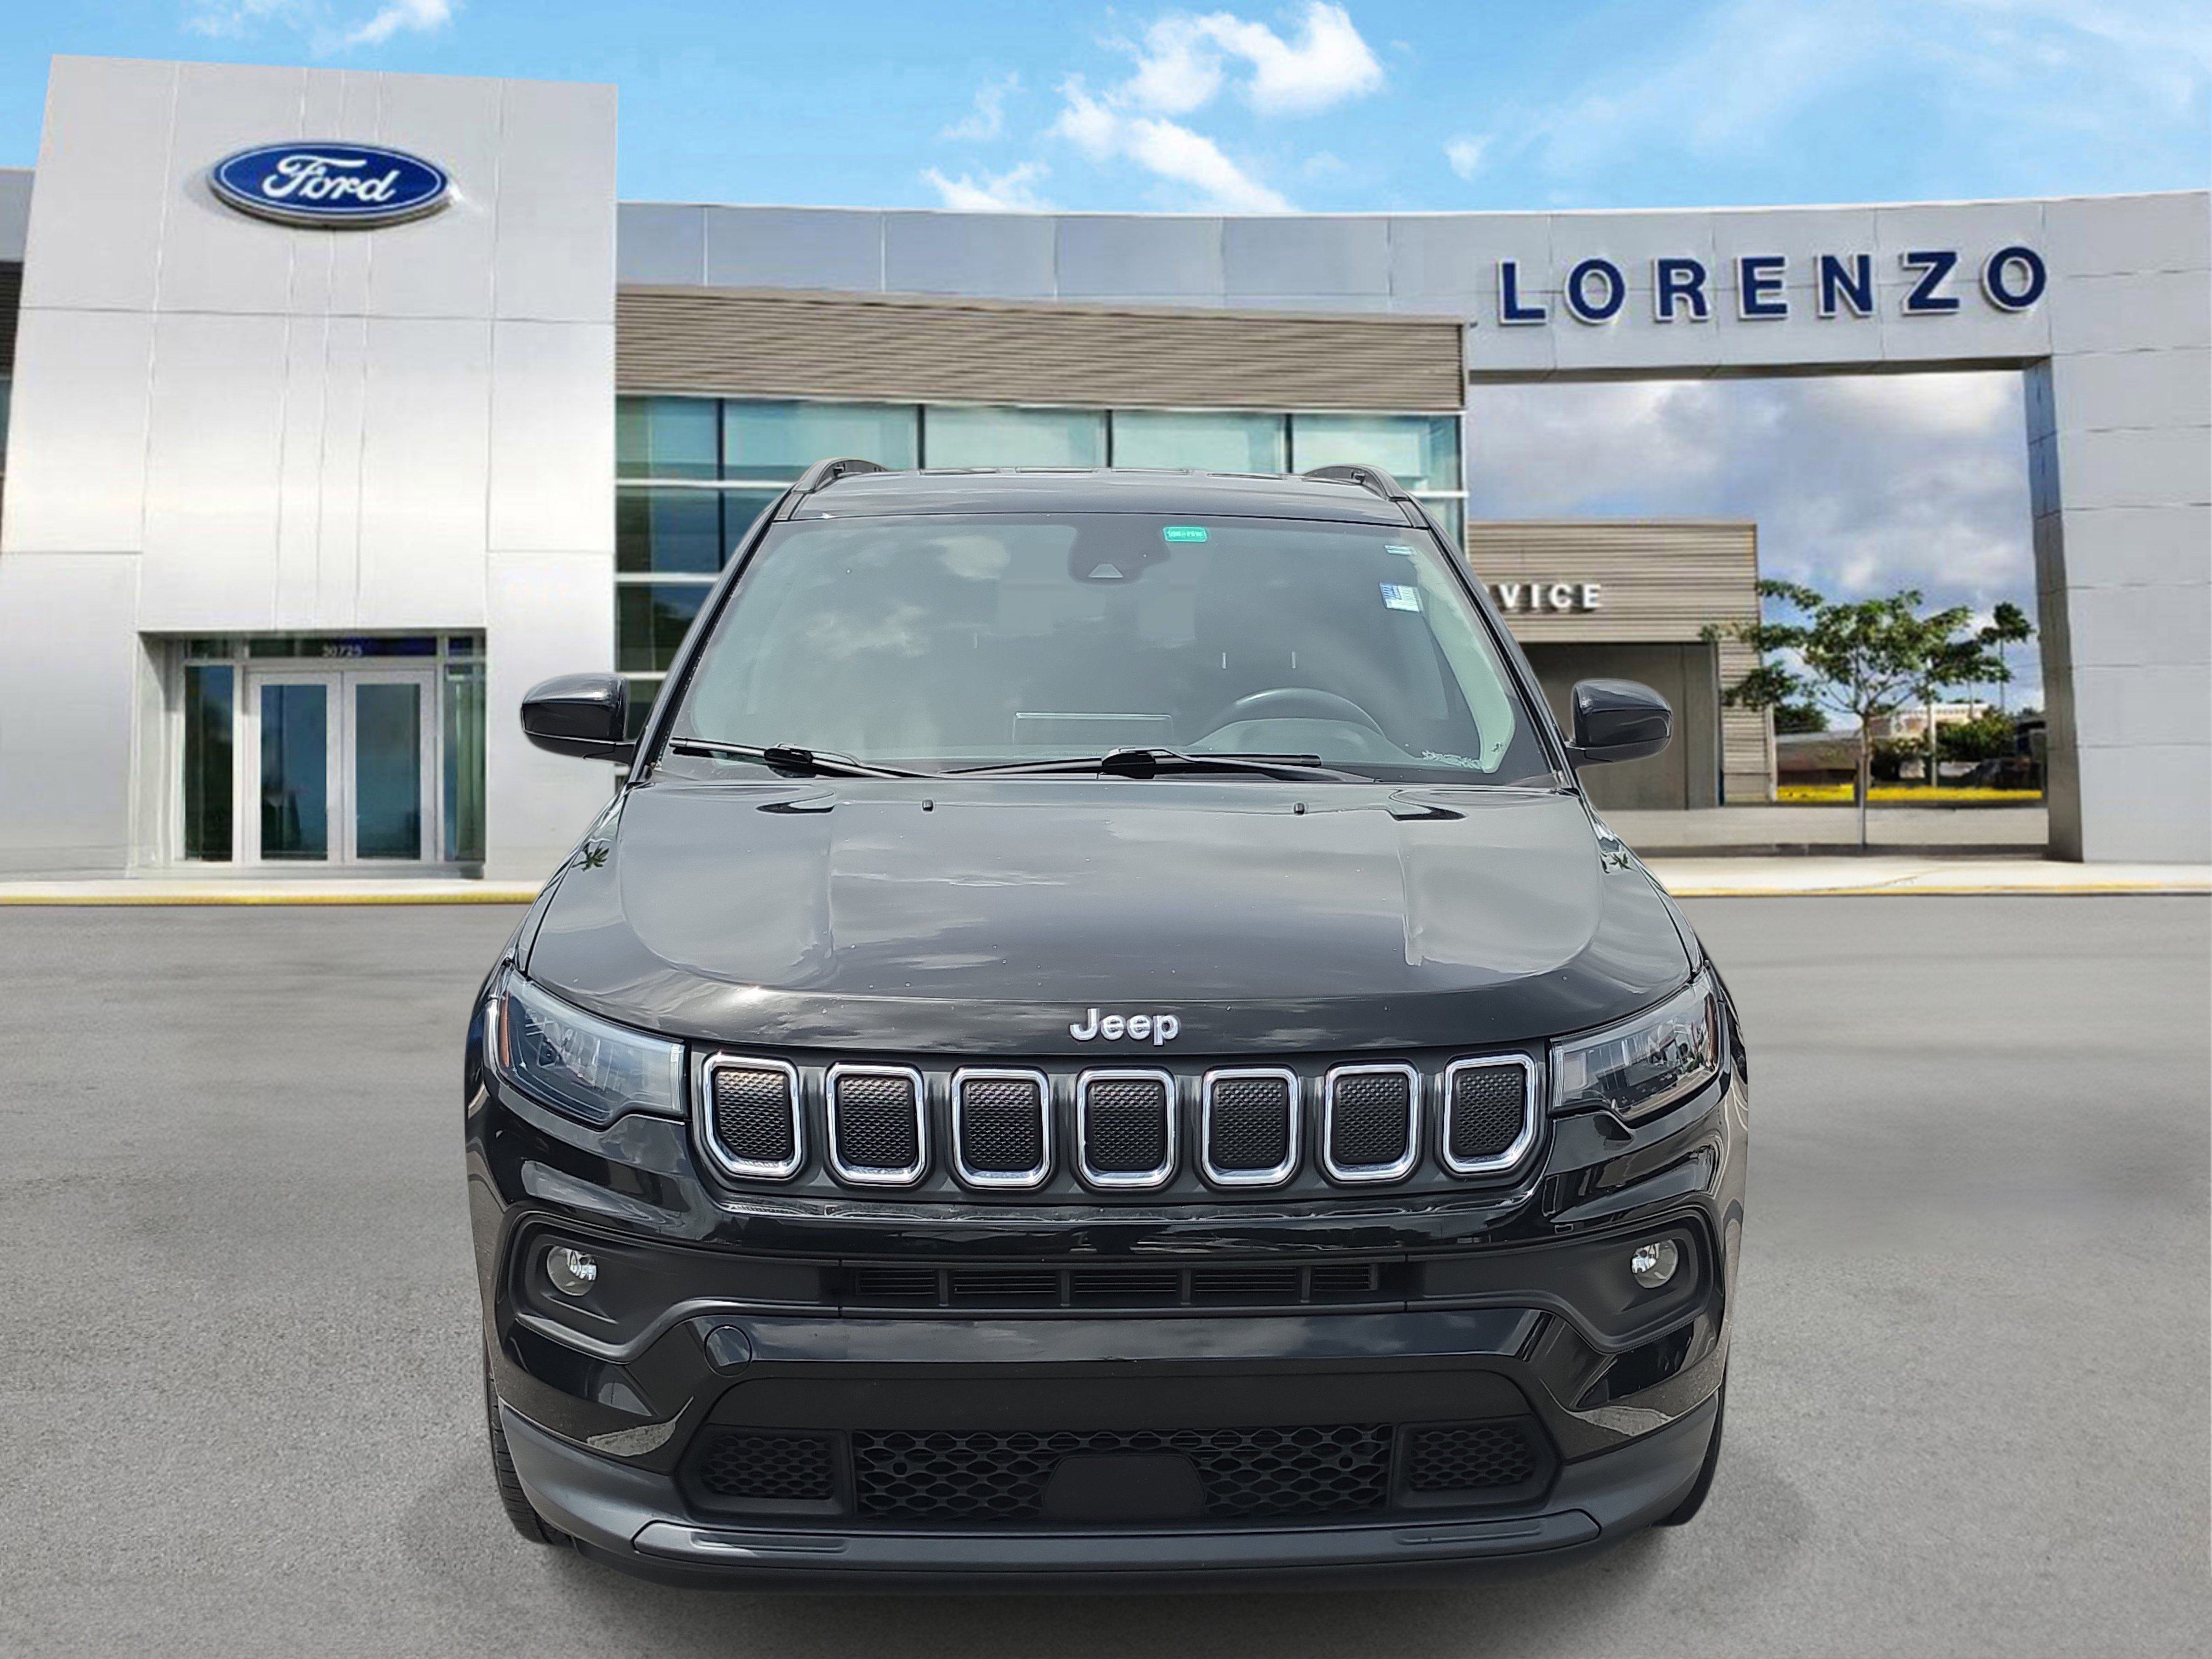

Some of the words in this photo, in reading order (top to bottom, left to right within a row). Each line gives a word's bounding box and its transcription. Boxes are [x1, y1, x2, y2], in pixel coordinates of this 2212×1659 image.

[262, 155, 400, 201] Ford
[1499, 247, 2046, 324] LORENZO
[1483, 584, 1602, 608] VICE
[1070, 1007, 1180, 1045] Jeep
